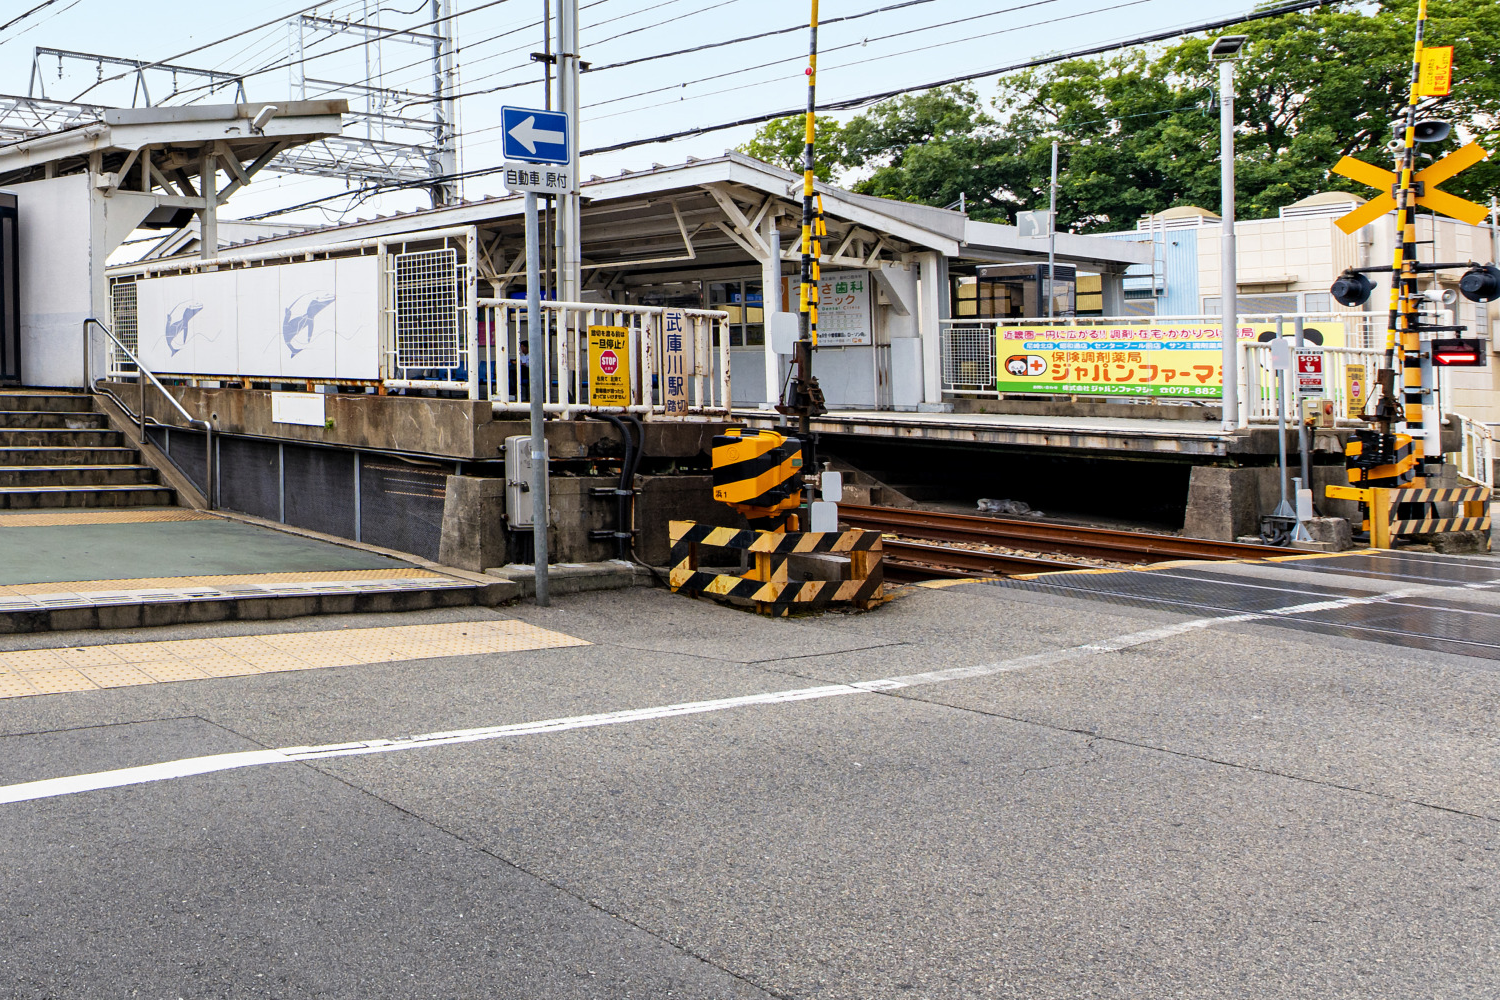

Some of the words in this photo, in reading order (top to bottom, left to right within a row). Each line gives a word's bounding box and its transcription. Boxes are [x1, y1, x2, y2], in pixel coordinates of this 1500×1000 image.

[507, 168, 568, 189] 自動車・原付
[793, 280, 863, 296] つさ歯科
[1110, 328, 1254, 340] 調剤・在宅・かかりつ局
[601, 356, 616, 366] STOP
[666, 312, 684, 397] 武庫川駅
[1051, 351, 1142, 364] 保険調剤薬局
[1051, 363, 1223, 384] ジャパンファーマ
[667, 399, 685, 413] 踏切
